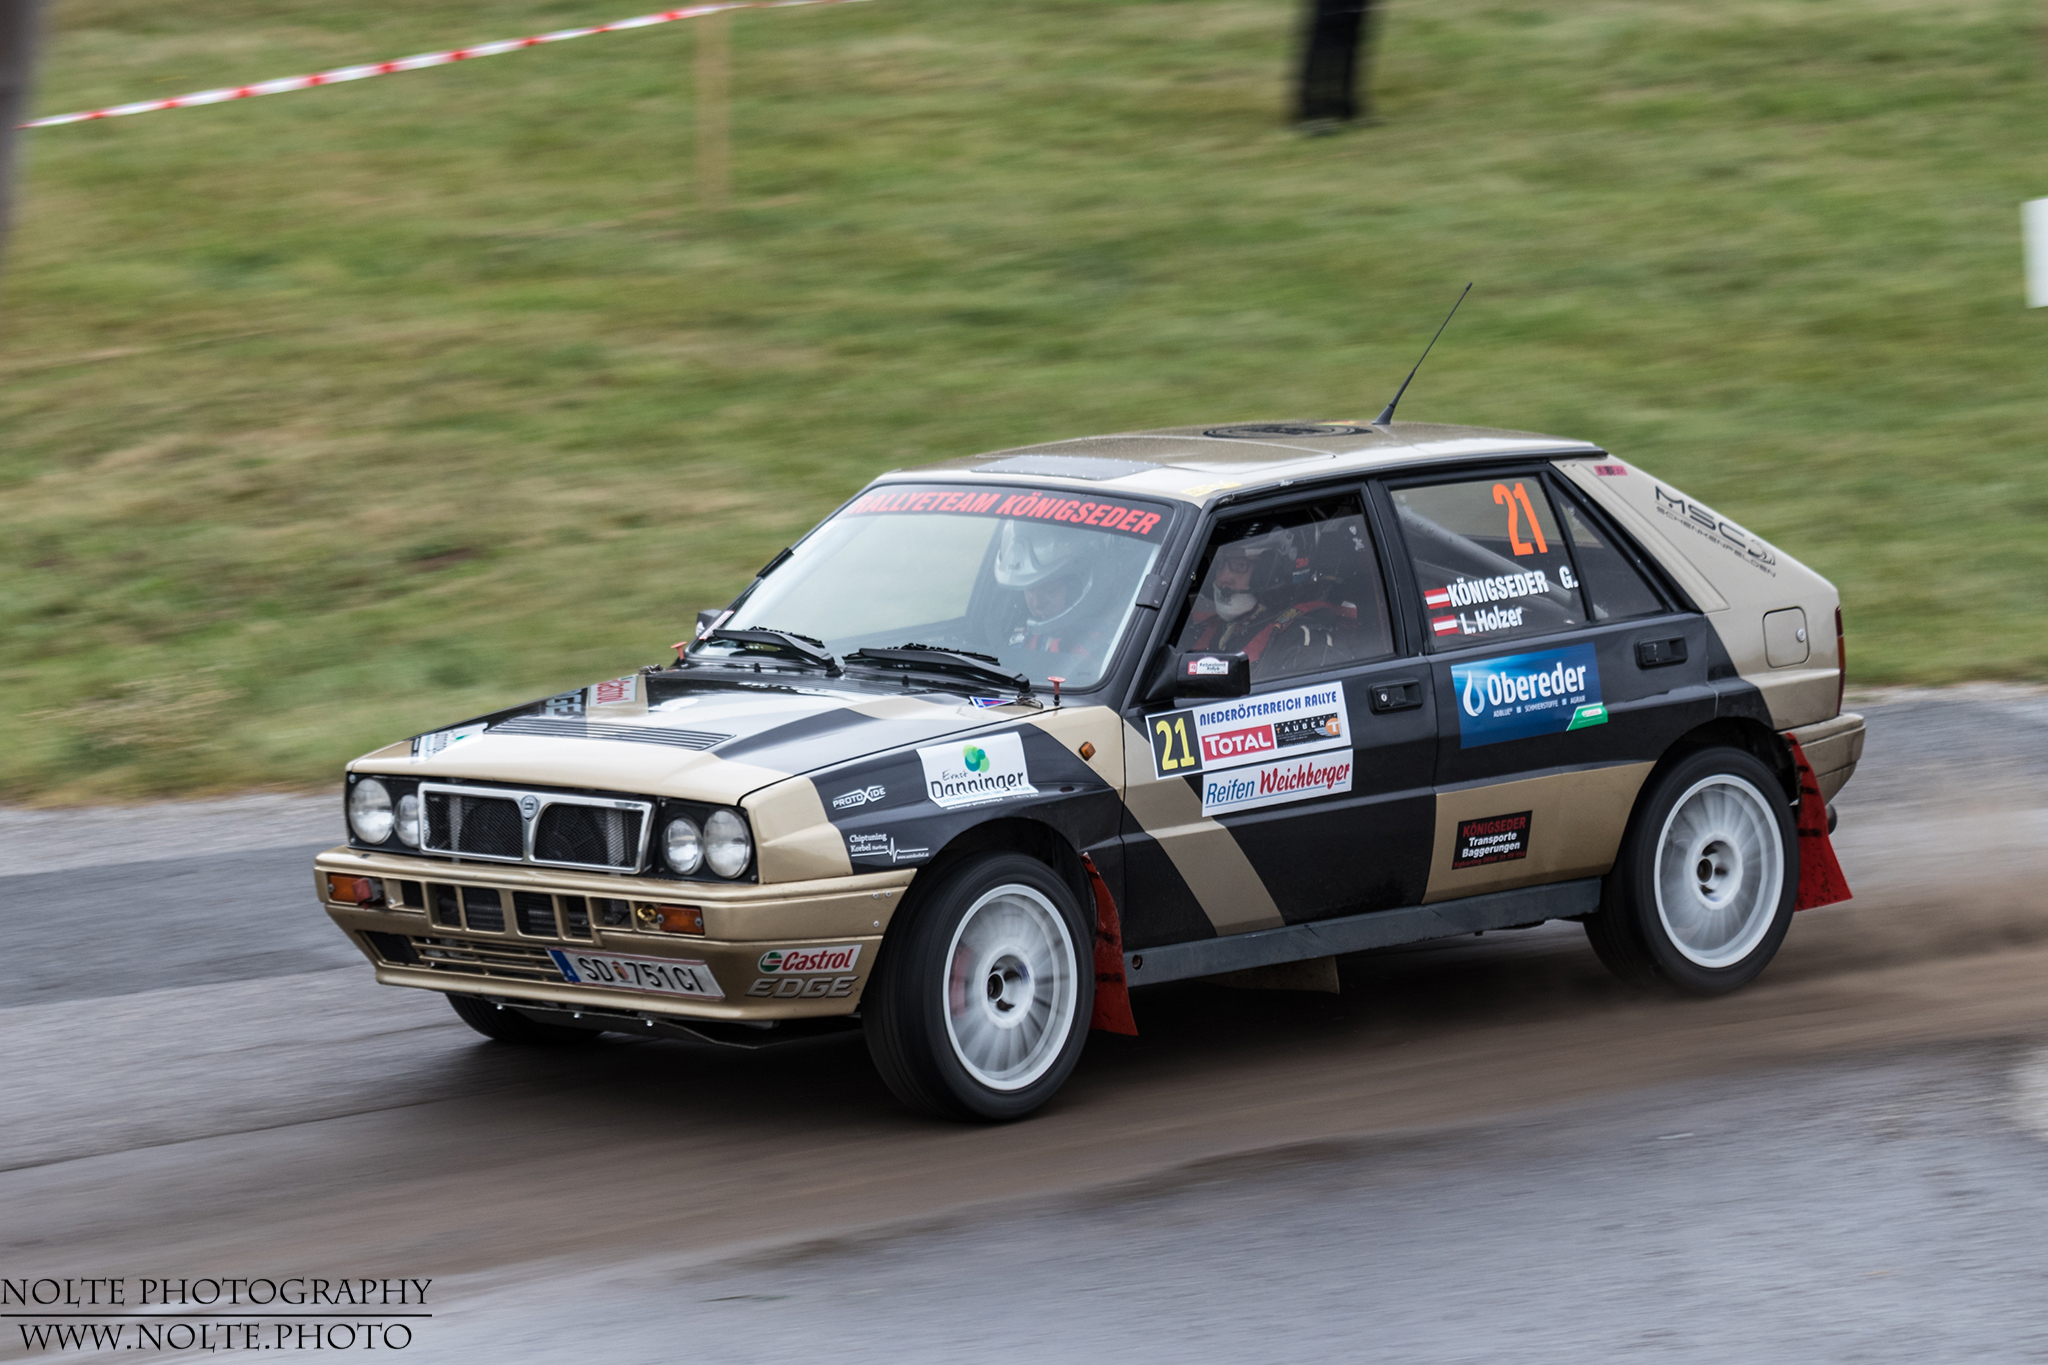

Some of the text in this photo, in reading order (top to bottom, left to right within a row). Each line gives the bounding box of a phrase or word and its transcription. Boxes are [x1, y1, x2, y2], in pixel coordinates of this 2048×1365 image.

[849, 491, 1161, 536] RALLYETEAM KÖNIGSEDER
[1493, 483, 1548, 556] 21
[1655, 486, 1746, 549] MSC
[1447, 565, 1579, 607] KÖNIGSEDER G.
[1460, 606, 1523, 635] L. Holzer
[1487, 661, 1586, 706] Obereder
[1199, 691, 1337, 727] NIEDERÖSTERREICH RALLYE
[1276, 719, 1325, 735] TAUBER
[1155, 717, 1196, 771] 21
[930, 772, 1024, 799] Danninger
[942, 769, 968, 781] Ernst
[1205, 762, 1350, 806] Reifen Weichberger
[849, 833, 887, 843] Chiptuning
[1462, 816, 1526, 838] KÖNIGSEDER
[1468, 831, 1518, 847] Transporte
[1461, 842, 1521, 858] Baggerungen
[577, 957, 615, 982] SD
[782, 948, 854, 971] Castrol
[744, 976, 859, 998] EDGE
